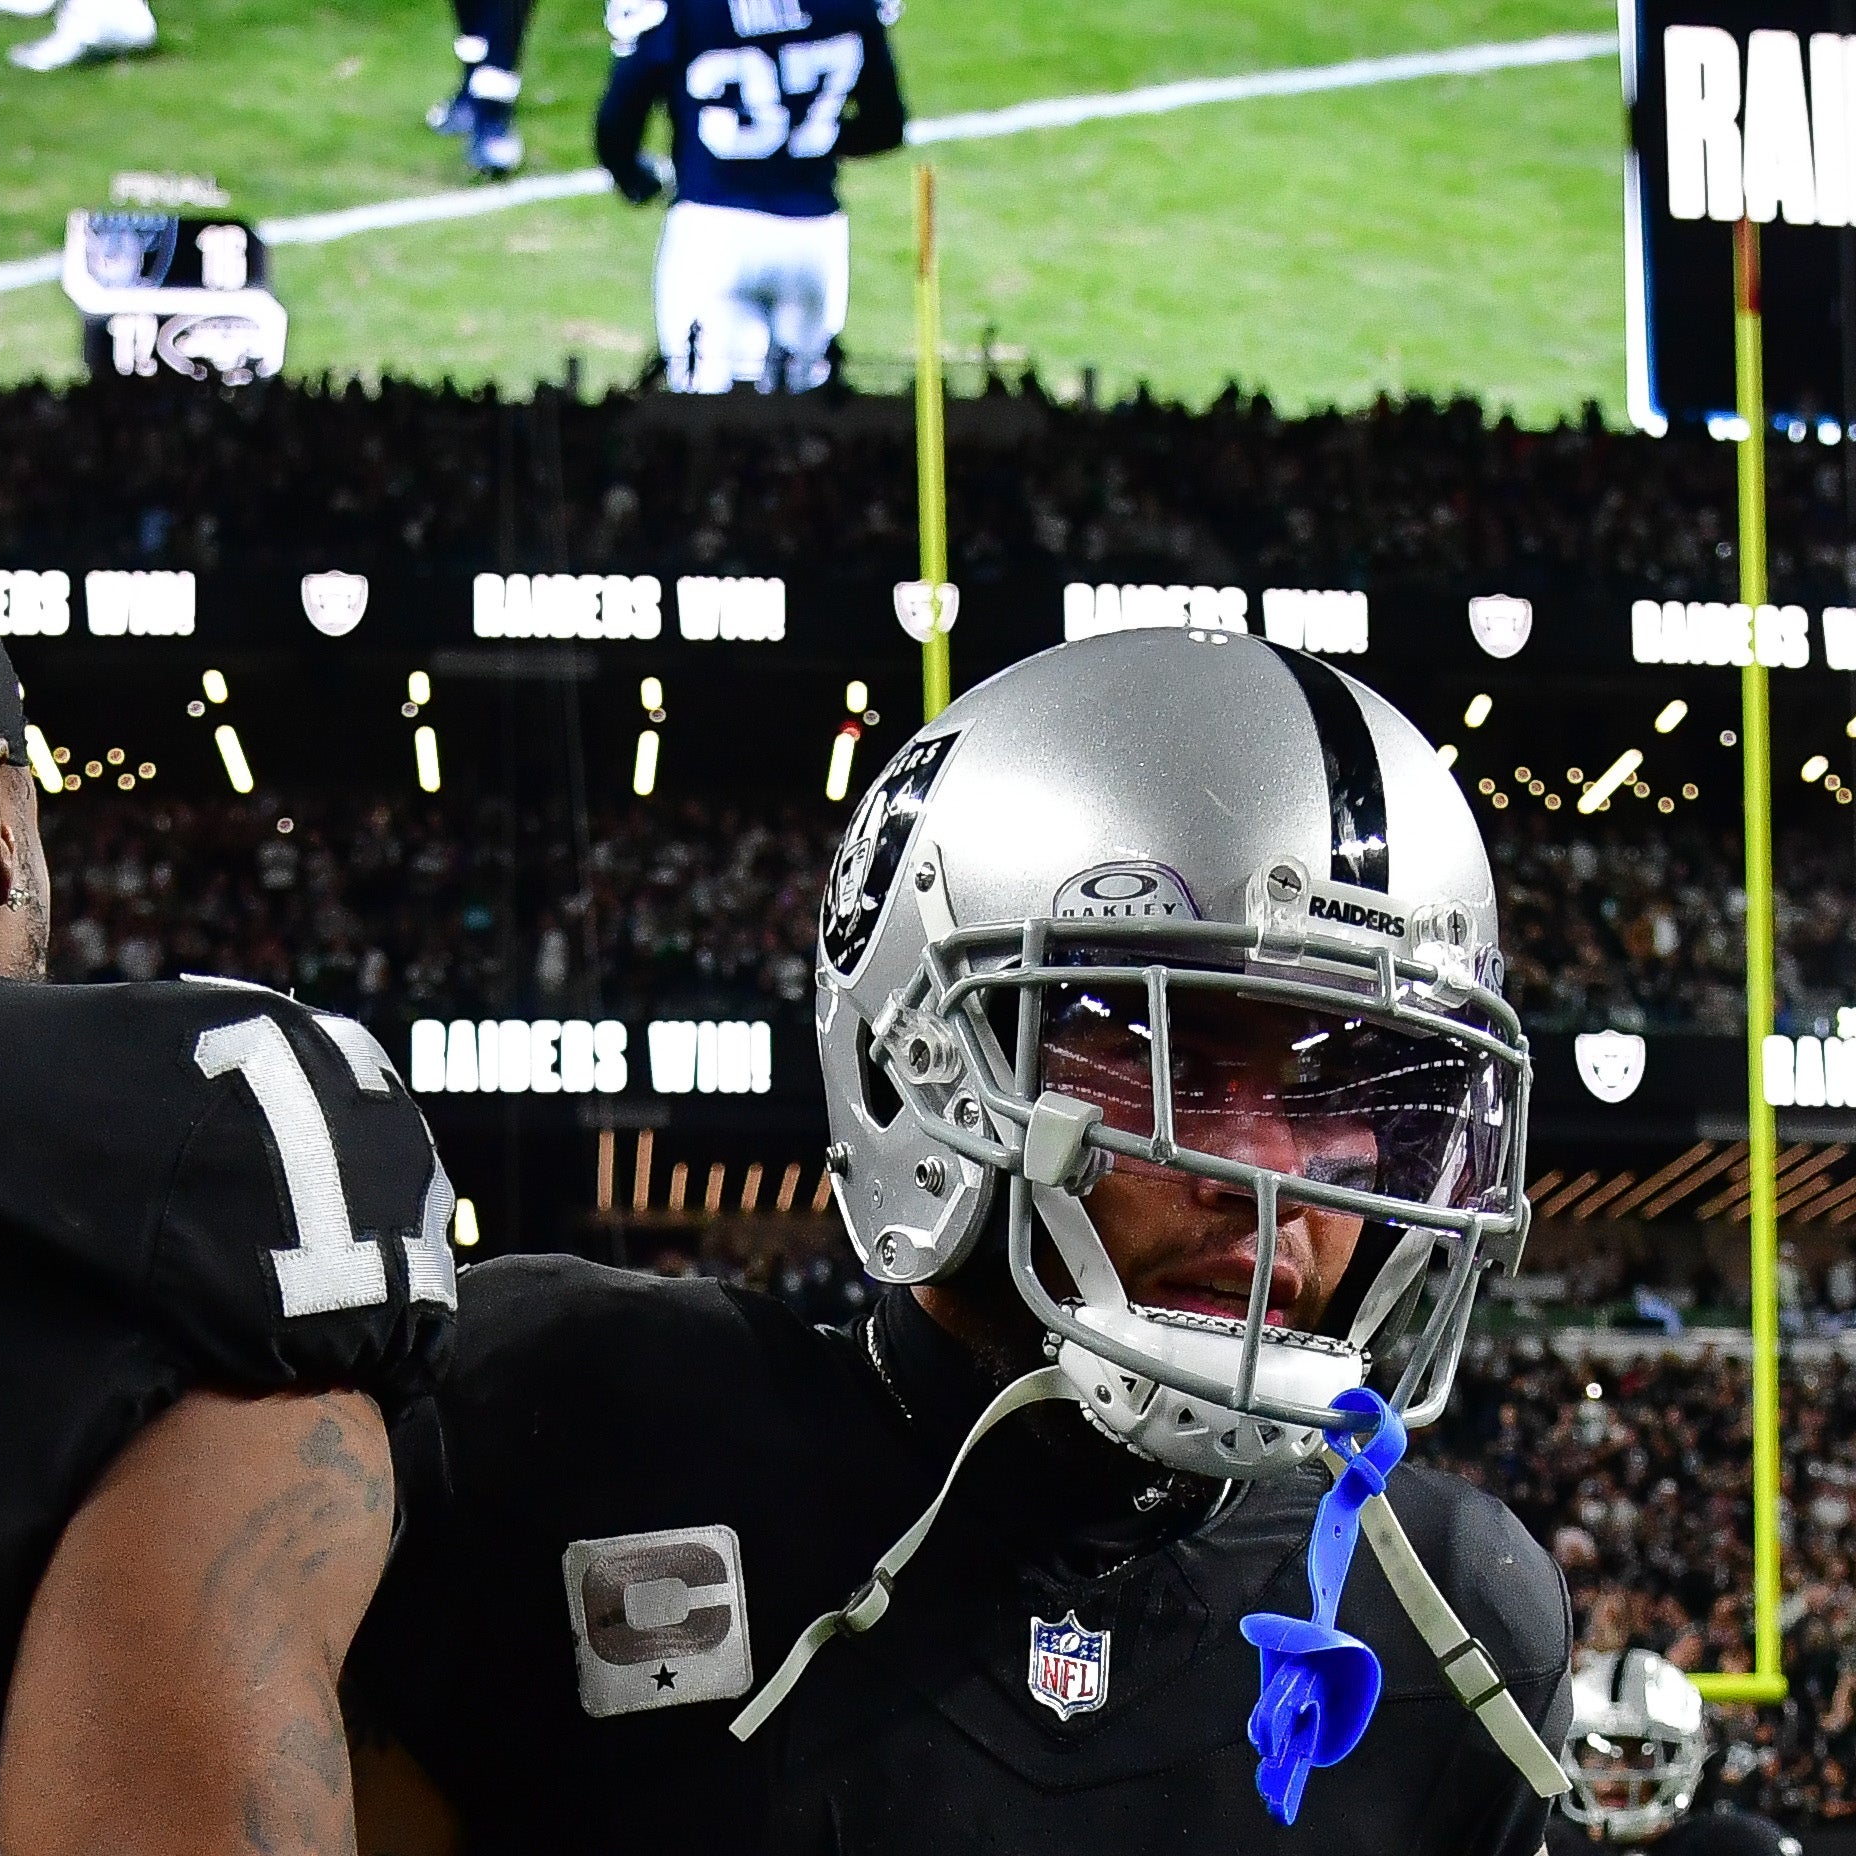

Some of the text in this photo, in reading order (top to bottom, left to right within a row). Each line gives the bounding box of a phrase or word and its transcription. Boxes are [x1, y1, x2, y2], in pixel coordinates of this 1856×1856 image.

[686, 30, 864, 160] 37
[1308, 895, 1405, 938] RAIDERS
[581, 1542, 732, 1665] C
[1041, 1655, 1094, 1701] NFL
